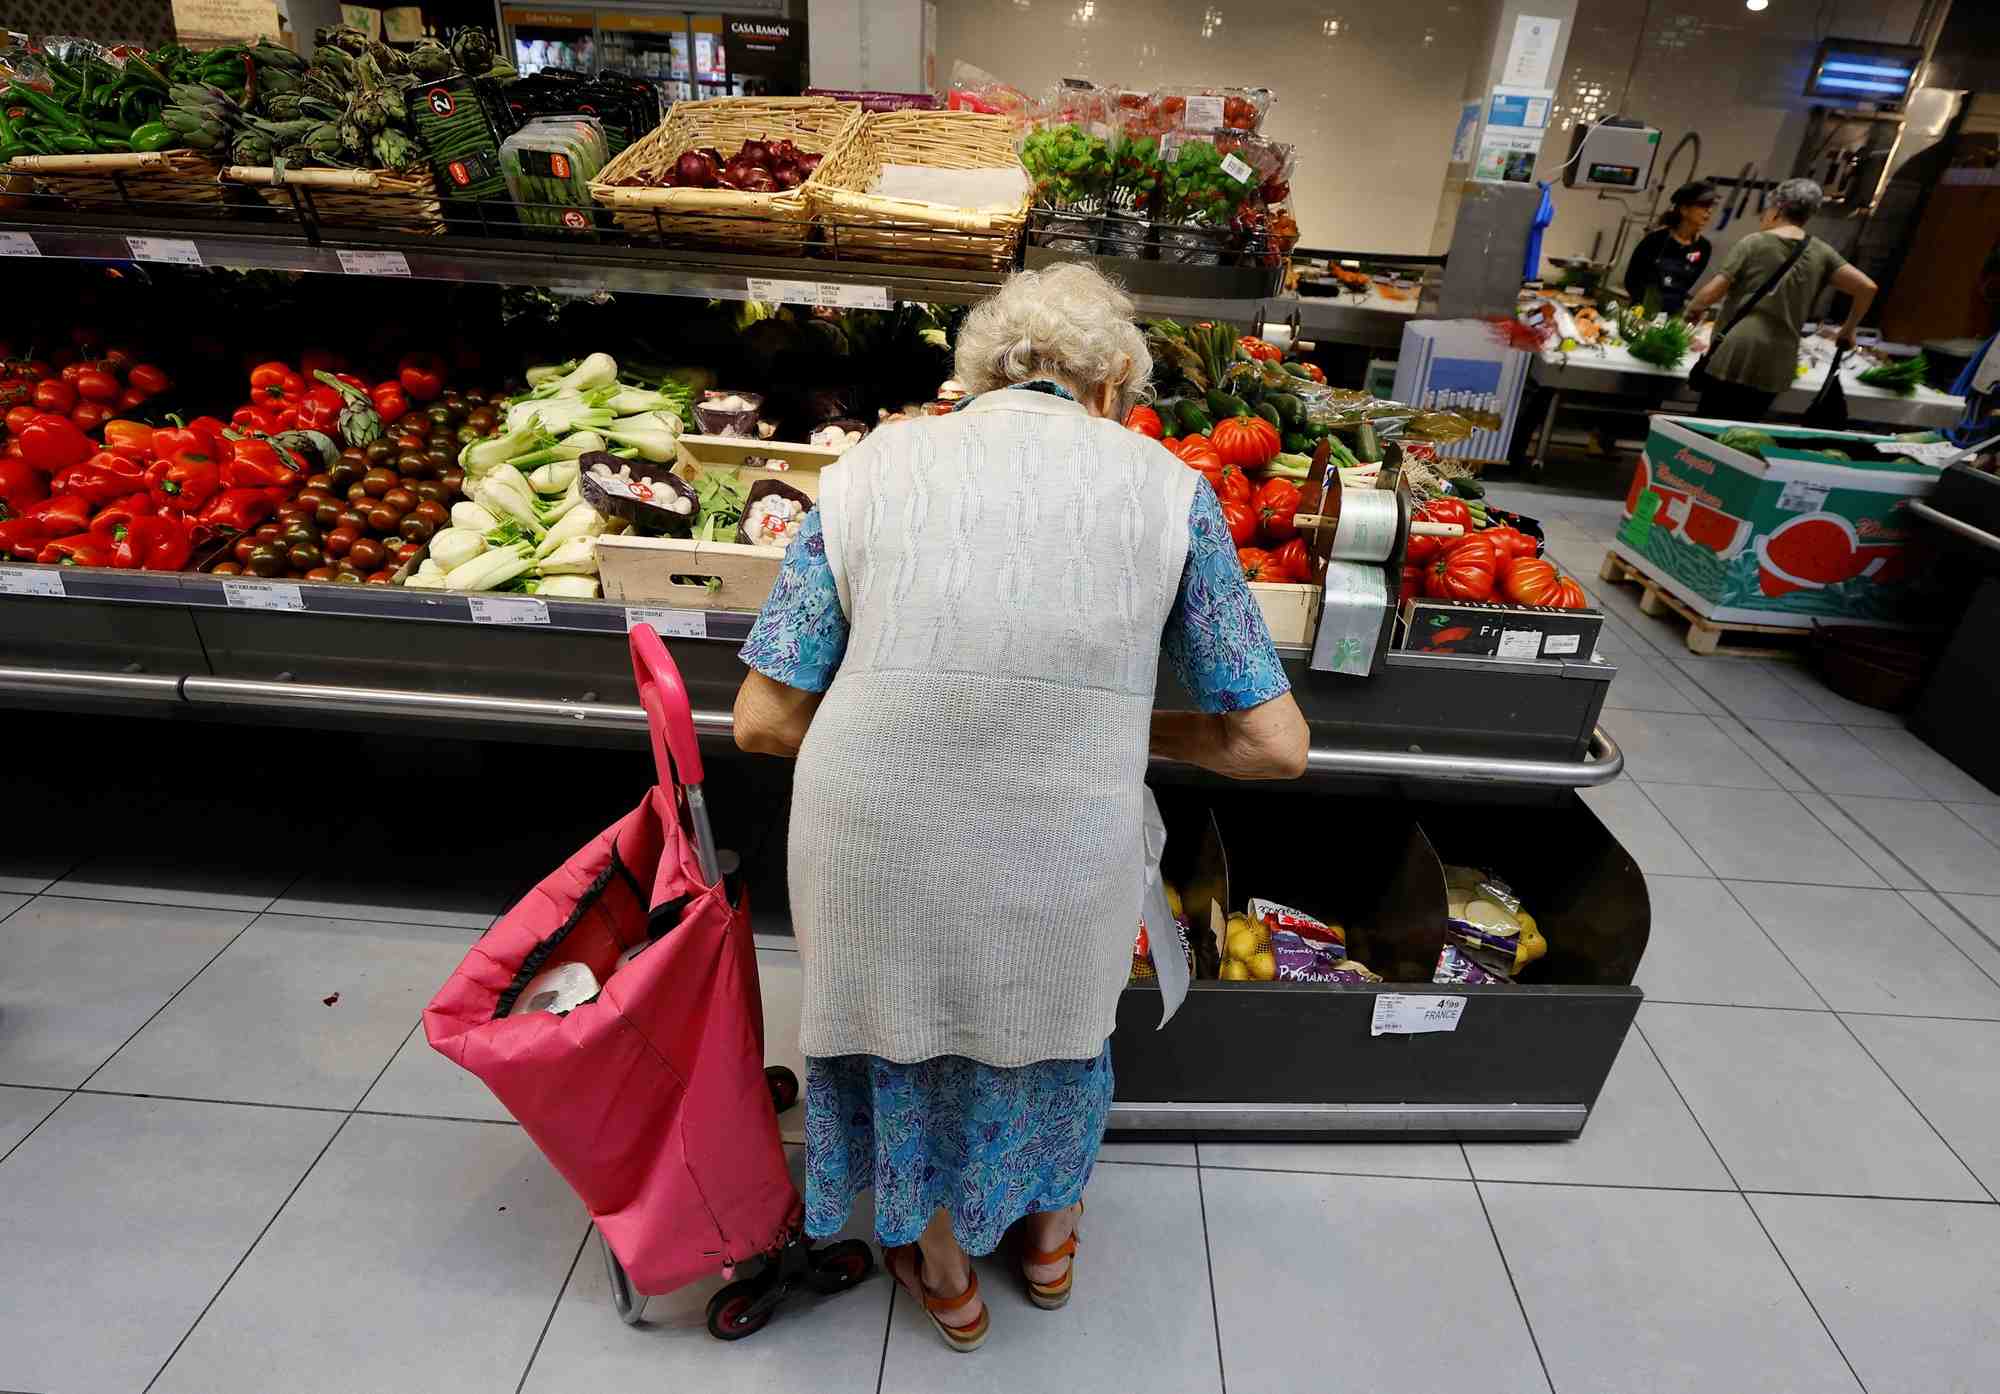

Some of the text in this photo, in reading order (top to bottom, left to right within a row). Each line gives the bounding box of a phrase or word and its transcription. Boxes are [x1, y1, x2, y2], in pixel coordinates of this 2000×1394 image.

[730, 21, 790, 38] CASA RAMÓN
[1424, 1009, 1459, 1021] FRANCE
